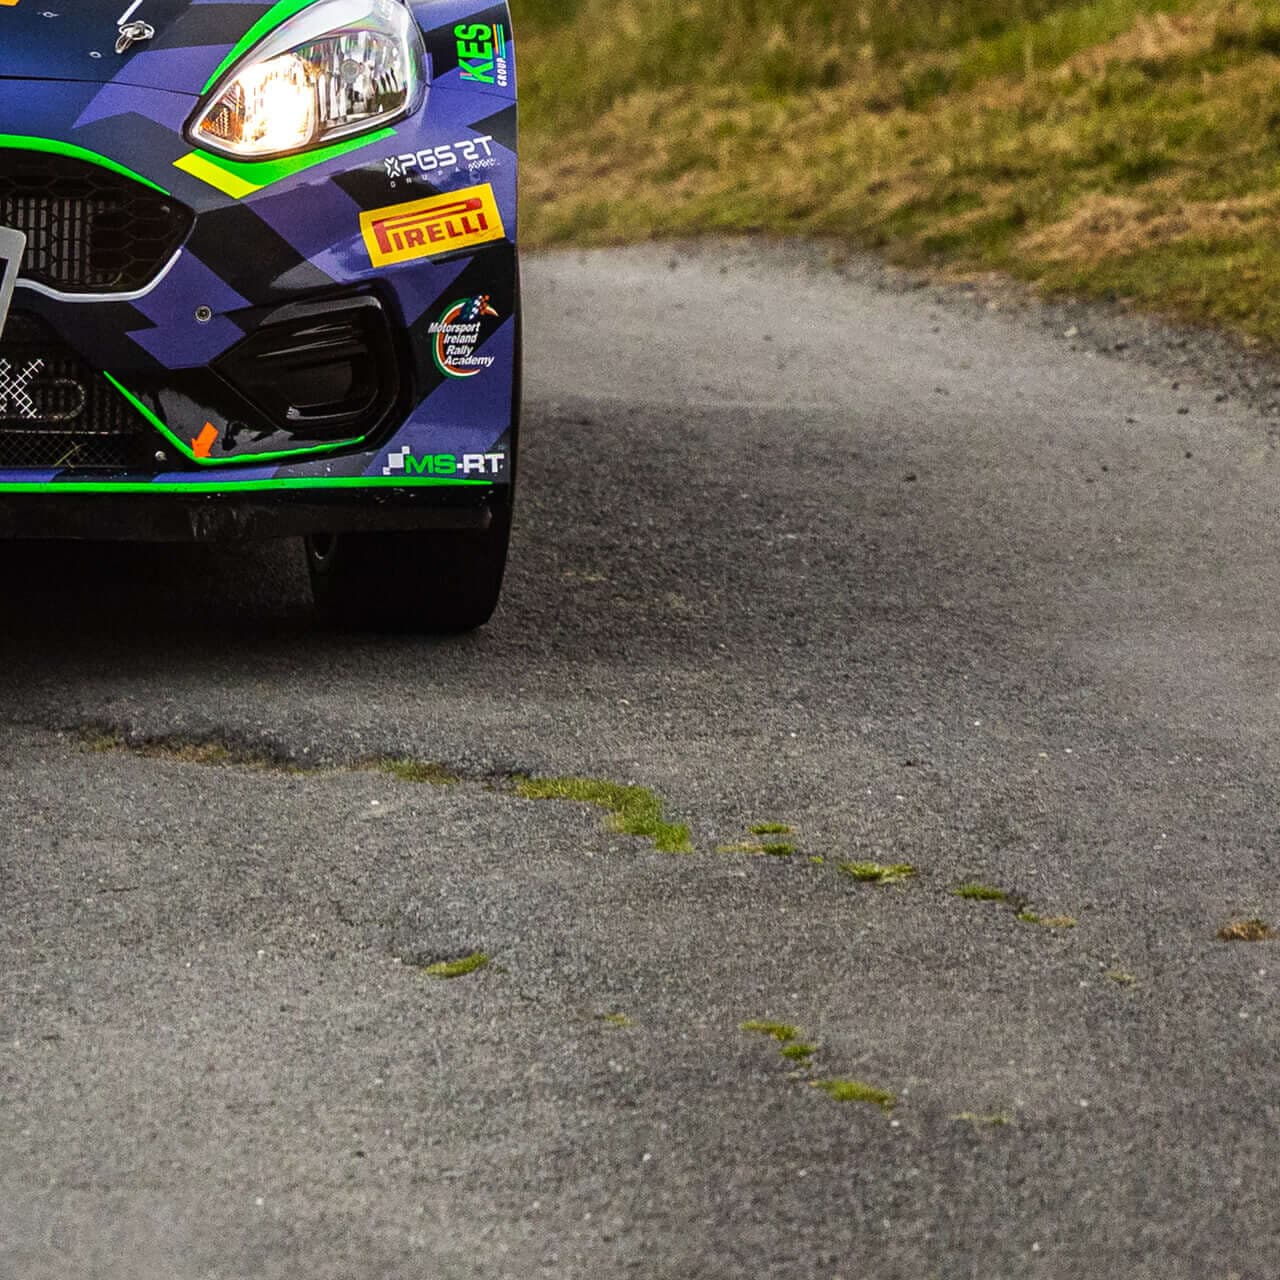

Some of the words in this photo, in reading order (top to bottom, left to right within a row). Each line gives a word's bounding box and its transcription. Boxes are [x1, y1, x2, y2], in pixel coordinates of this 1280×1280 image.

[453, 23, 495, 85] KES
[371, 197, 489, 255] PIRELLI
[428, 321, 481, 335] Motorsport
[443, 333, 478, 345] Ireland
[446, 344, 474, 357] Rally
[444, 354, 495, 368] Academy
